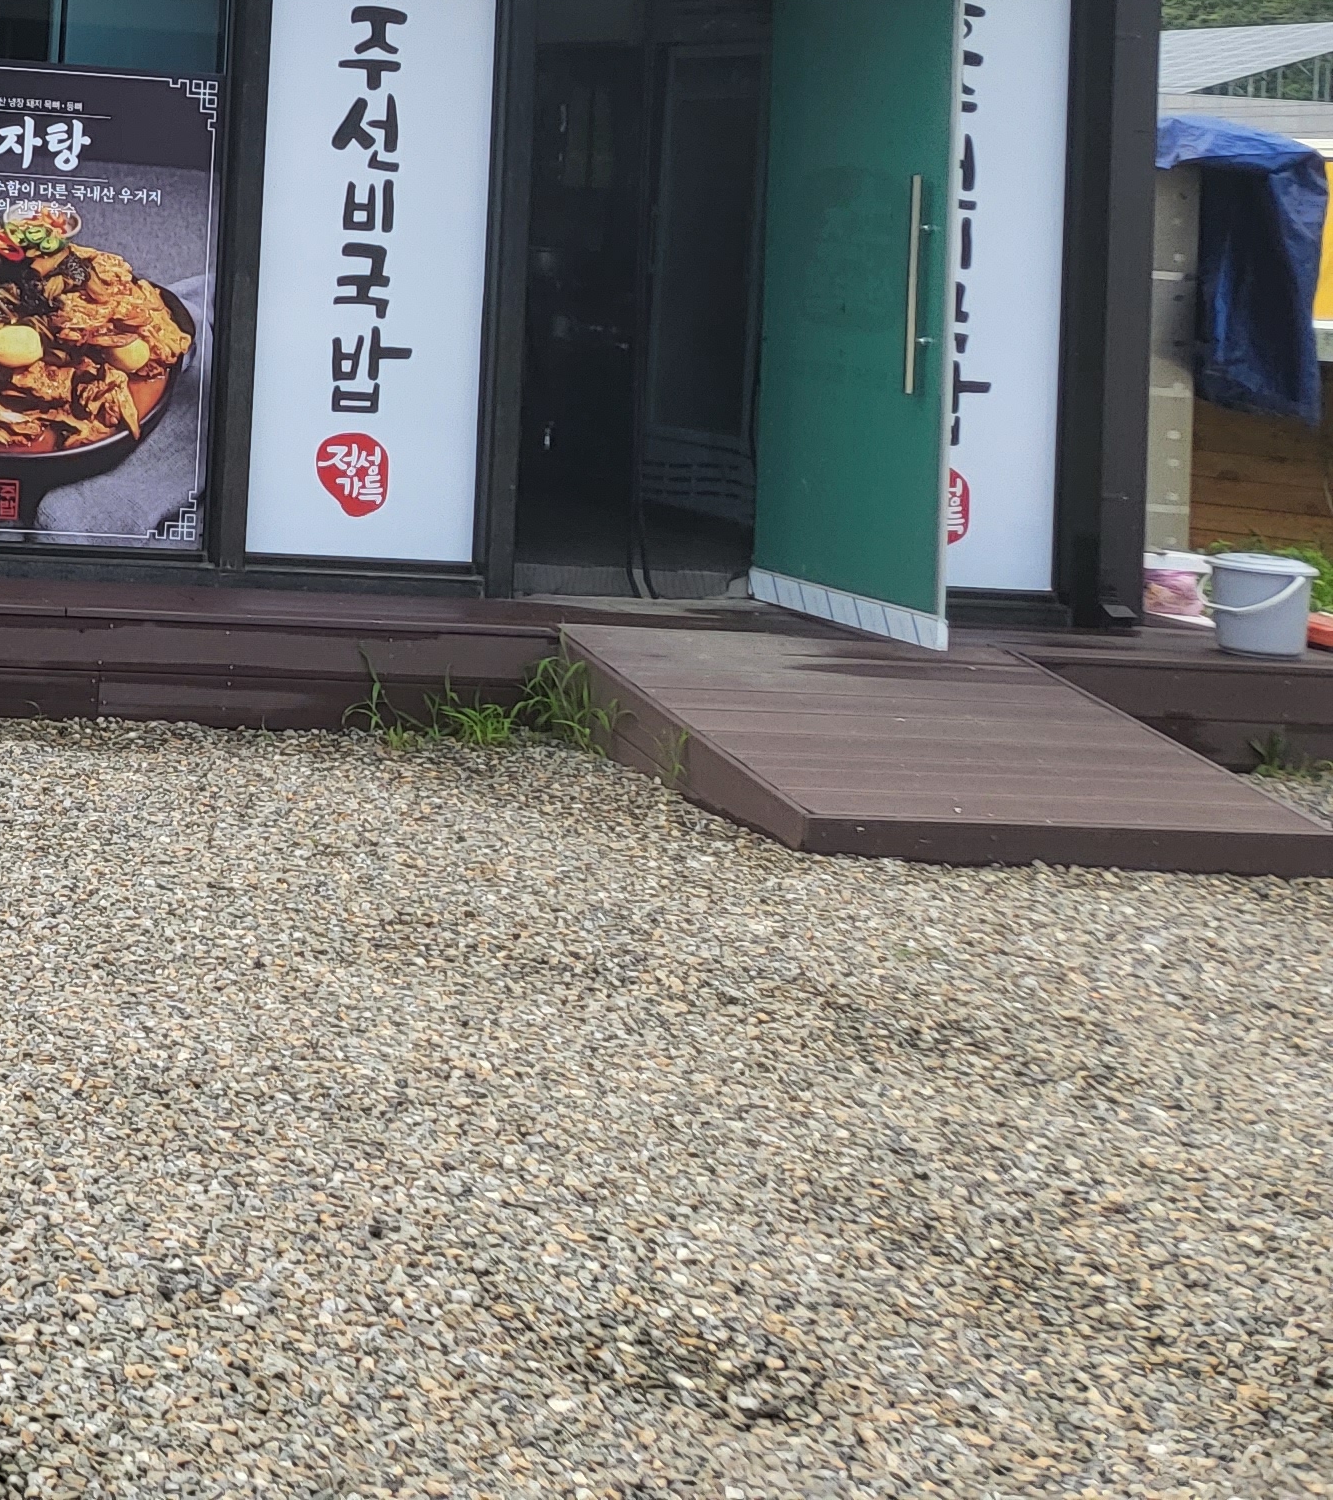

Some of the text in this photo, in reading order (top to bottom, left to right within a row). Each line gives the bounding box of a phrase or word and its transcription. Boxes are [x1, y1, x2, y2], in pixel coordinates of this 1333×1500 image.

[39, 181, 68, 200] 다른
[71, 184, 116, 203] 국내산
[118, 187, 162, 207] 우거지
[318, 441, 382, 479] 정성
[335, 472, 382, 505] 가득
